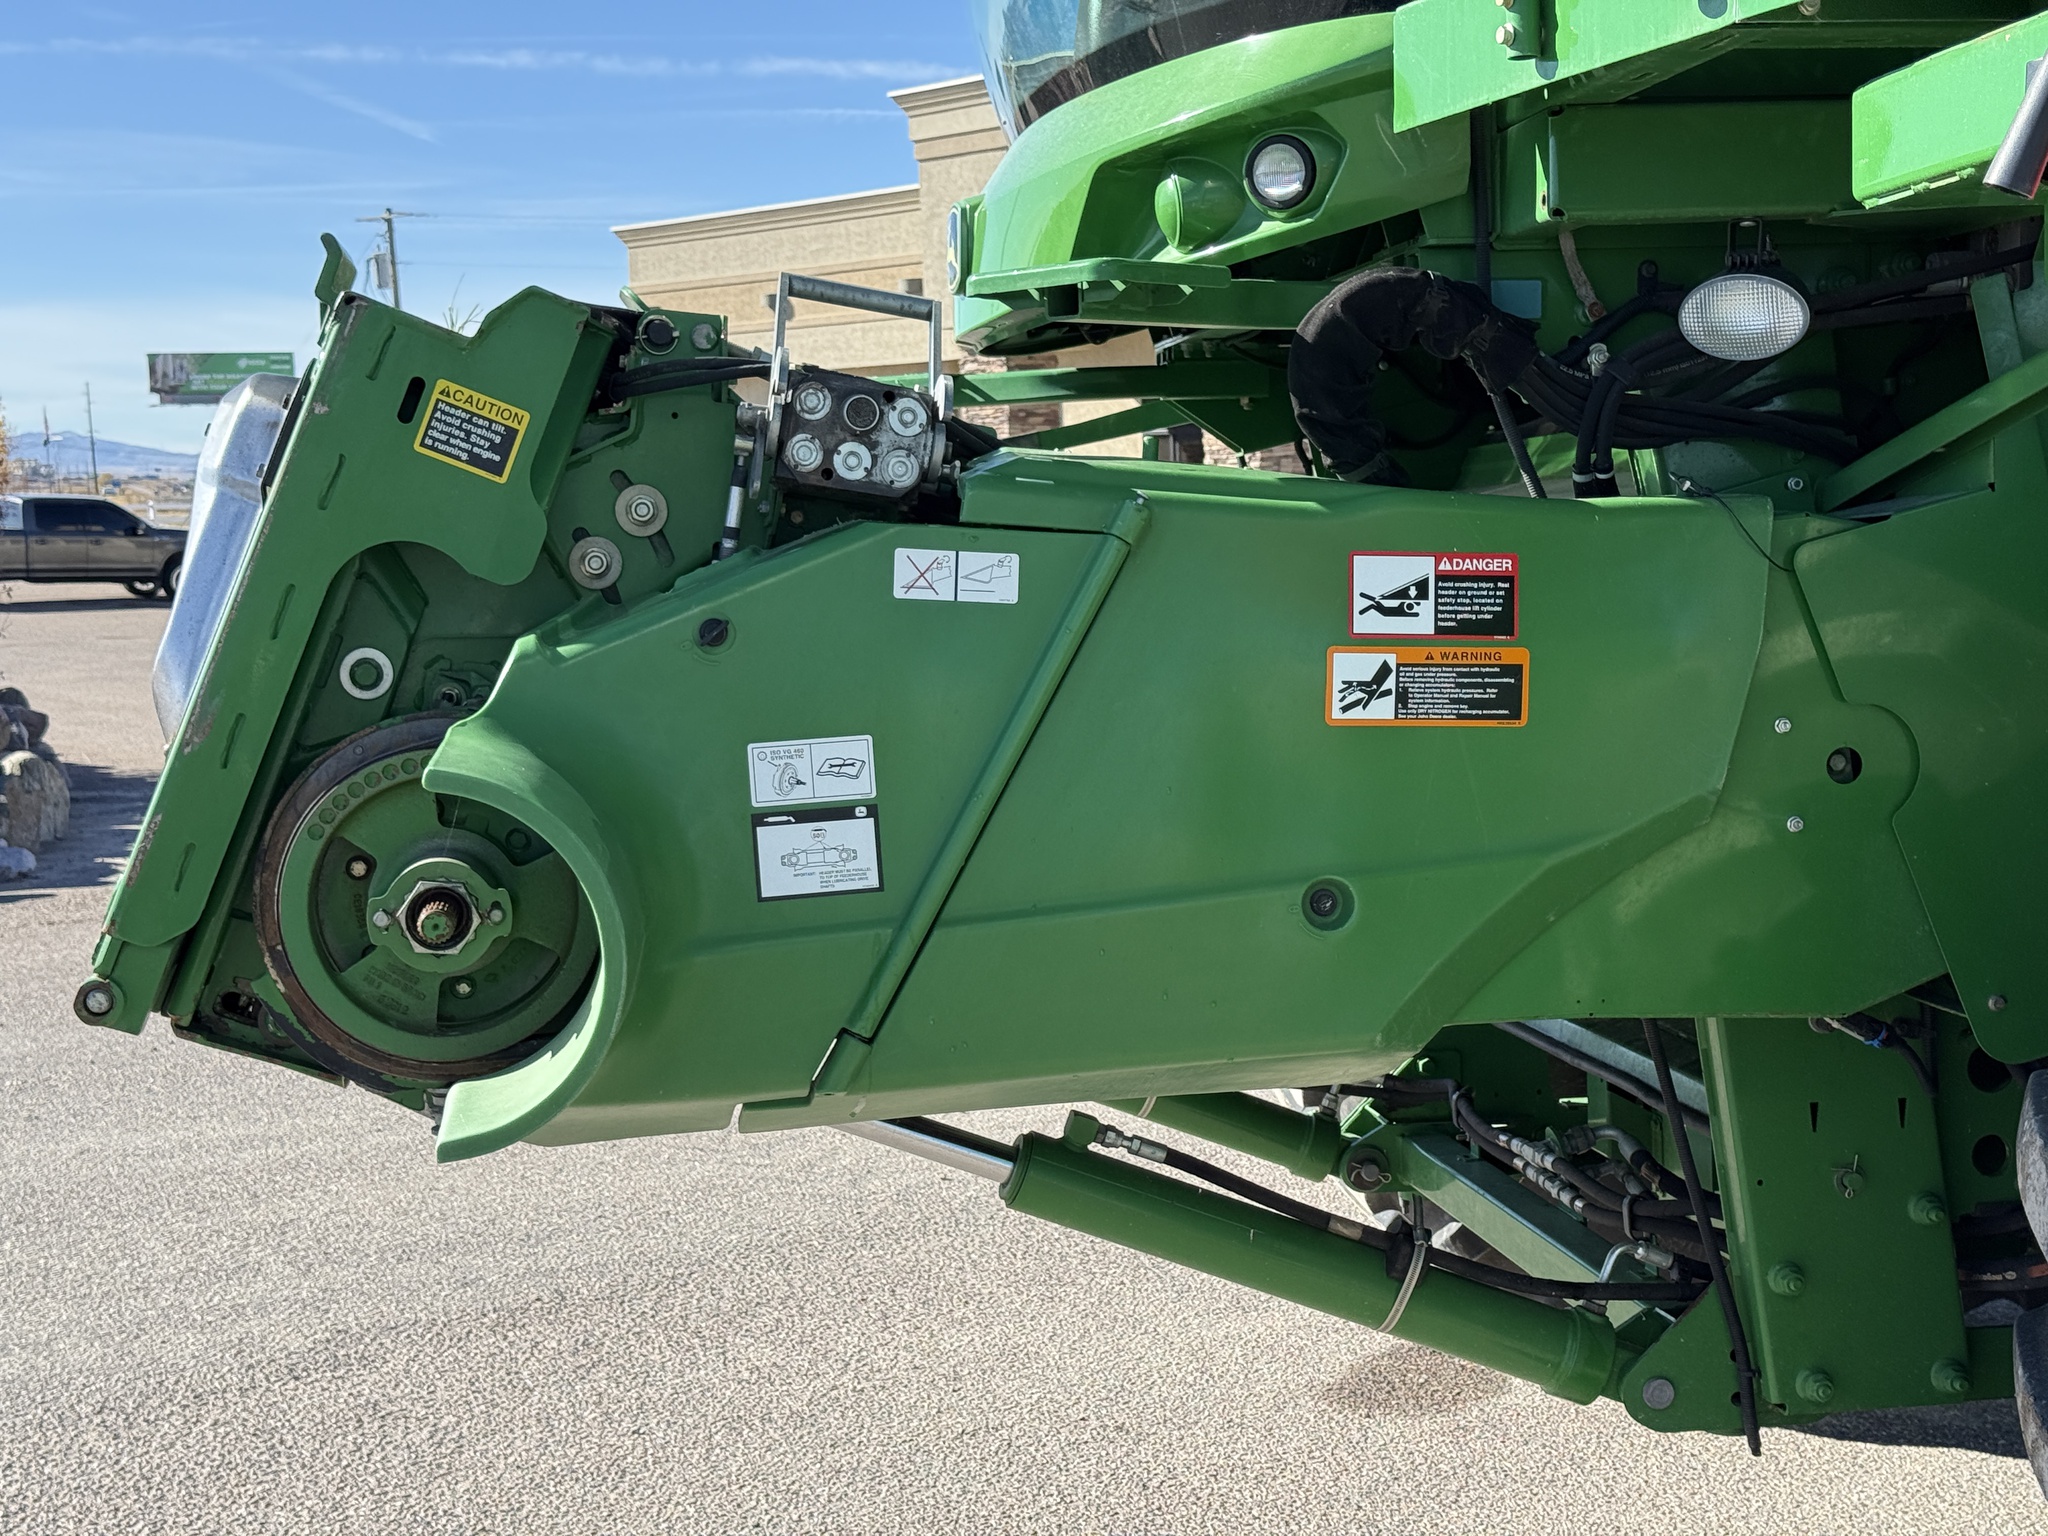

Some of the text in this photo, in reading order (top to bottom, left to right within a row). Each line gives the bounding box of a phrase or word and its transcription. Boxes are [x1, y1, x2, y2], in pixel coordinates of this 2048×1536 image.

[453, 389, 525, 426] CAUTION
[434, 411, 502, 444] Avoid crushing
[437, 401, 507, 435] Header can tilt.
[427, 428, 501, 462] clear when engine
[434, 441, 469, 461] running.
[470, 434, 491, 449] Stay
[1453, 558, 1512, 571] DANGER
[1440, 651, 1503, 661] WARNING
[770, 753, 804, 761] SYNTHETIC
